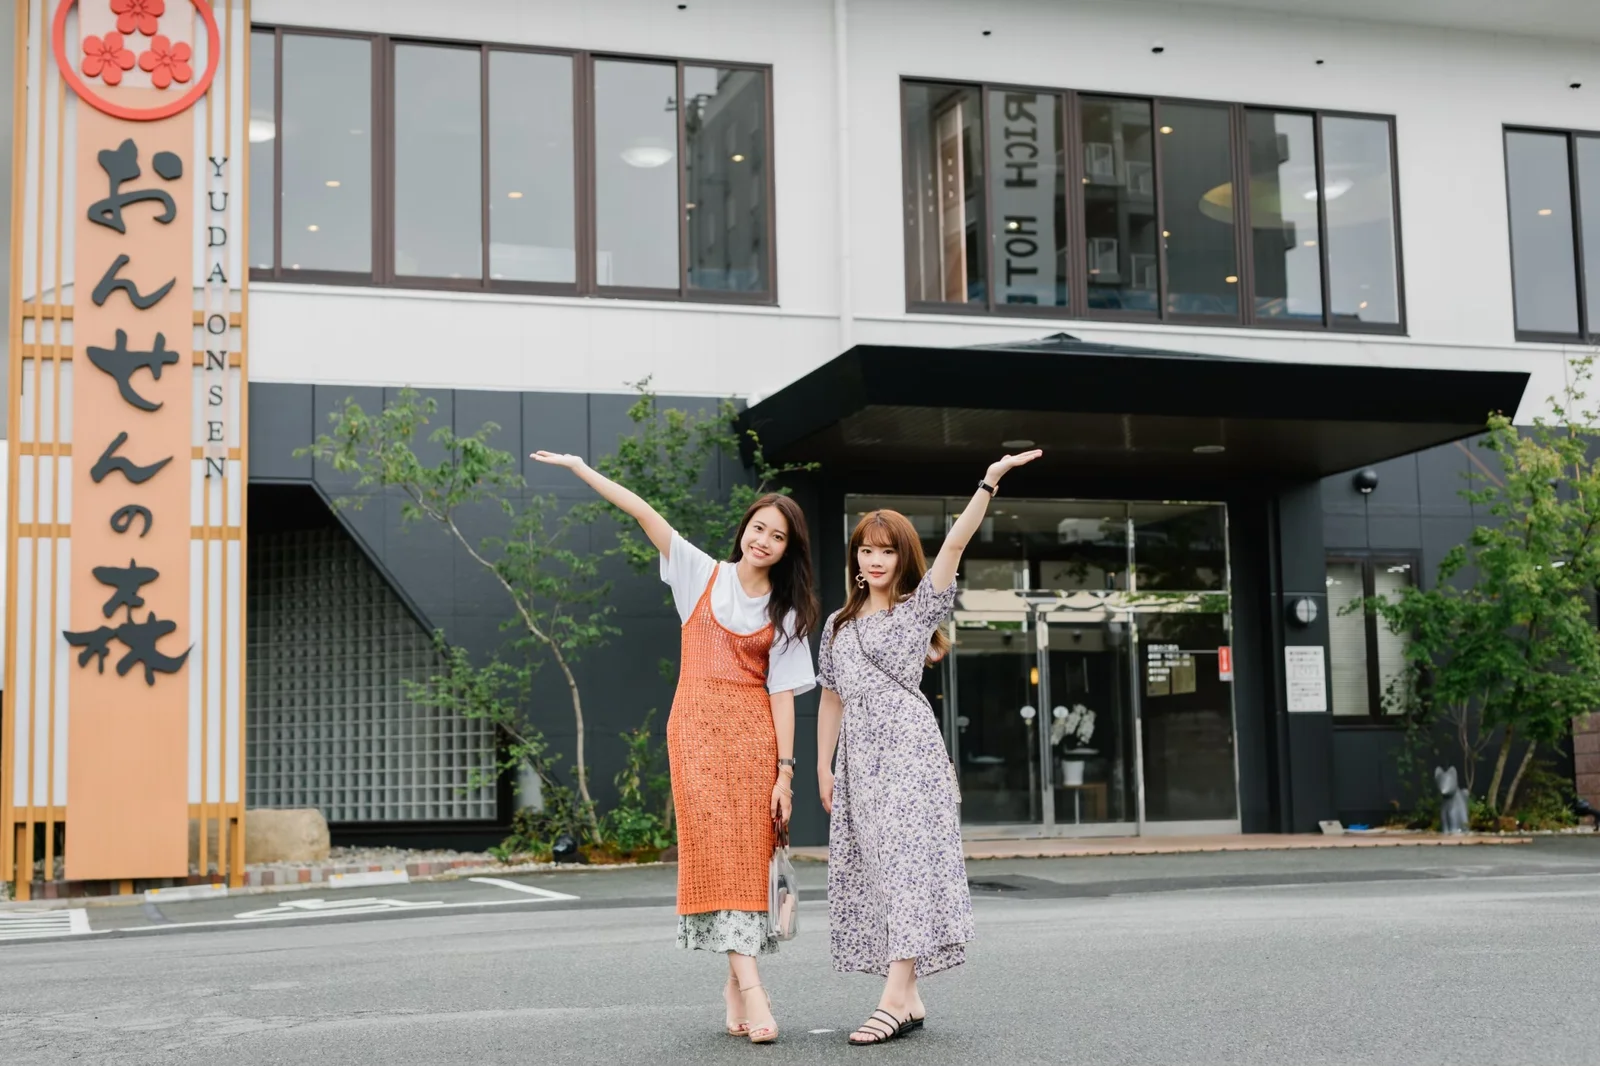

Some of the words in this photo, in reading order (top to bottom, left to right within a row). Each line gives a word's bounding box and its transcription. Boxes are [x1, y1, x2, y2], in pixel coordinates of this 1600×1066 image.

[205, 156, 229, 283] YUDA
[62, 138, 195, 687] おんせんの森
[204, 313, 228, 479] ONSEN
